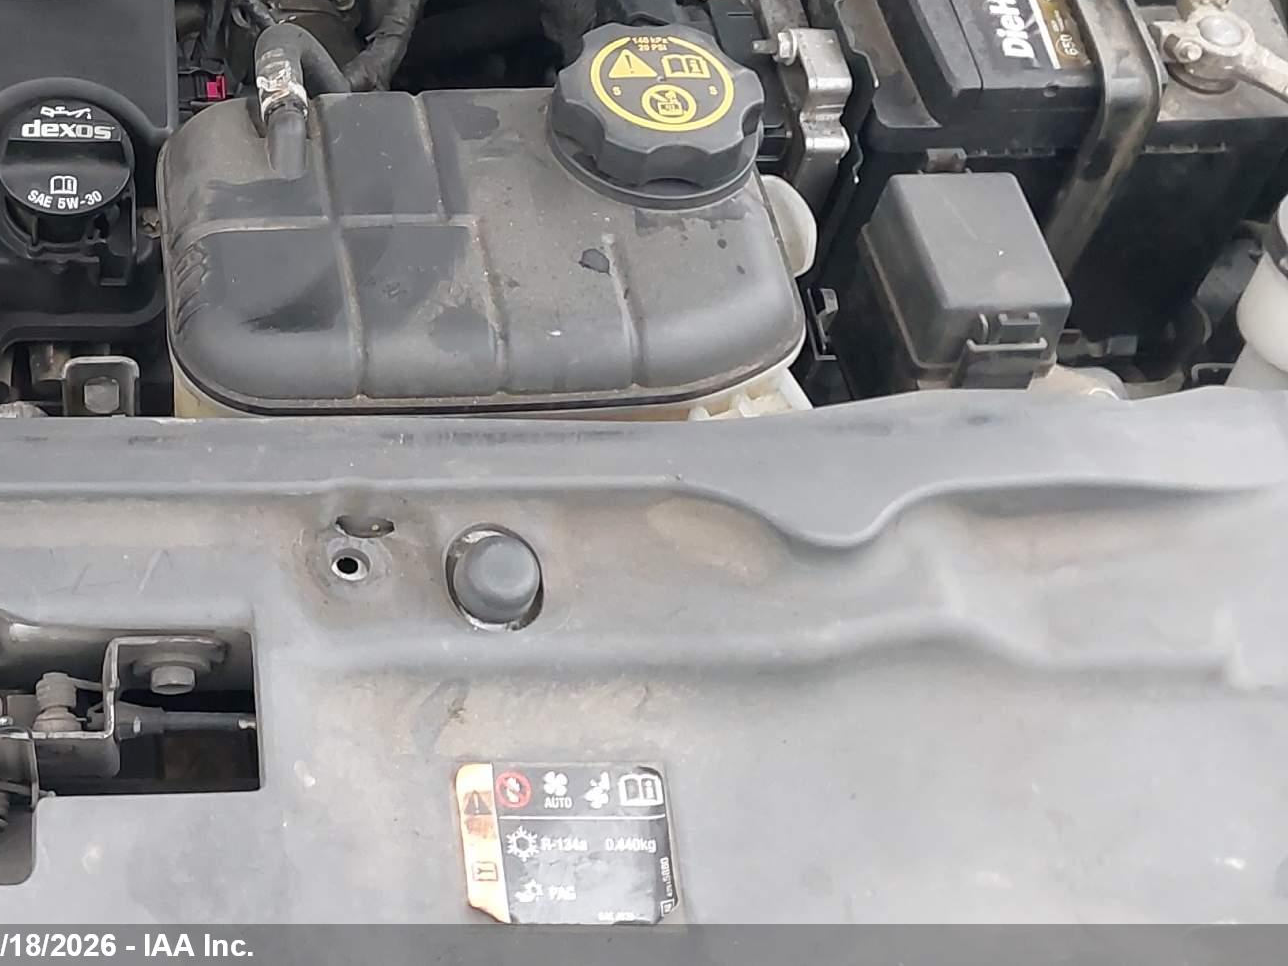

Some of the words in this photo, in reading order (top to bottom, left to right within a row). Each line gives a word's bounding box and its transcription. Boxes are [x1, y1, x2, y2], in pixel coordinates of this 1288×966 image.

[21, 119, 113, 140] dexos
[27, 190, 53, 209] SAE
[57, 190, 103, 210] 5W-30
[544, 797, 573, 809] AUTO
